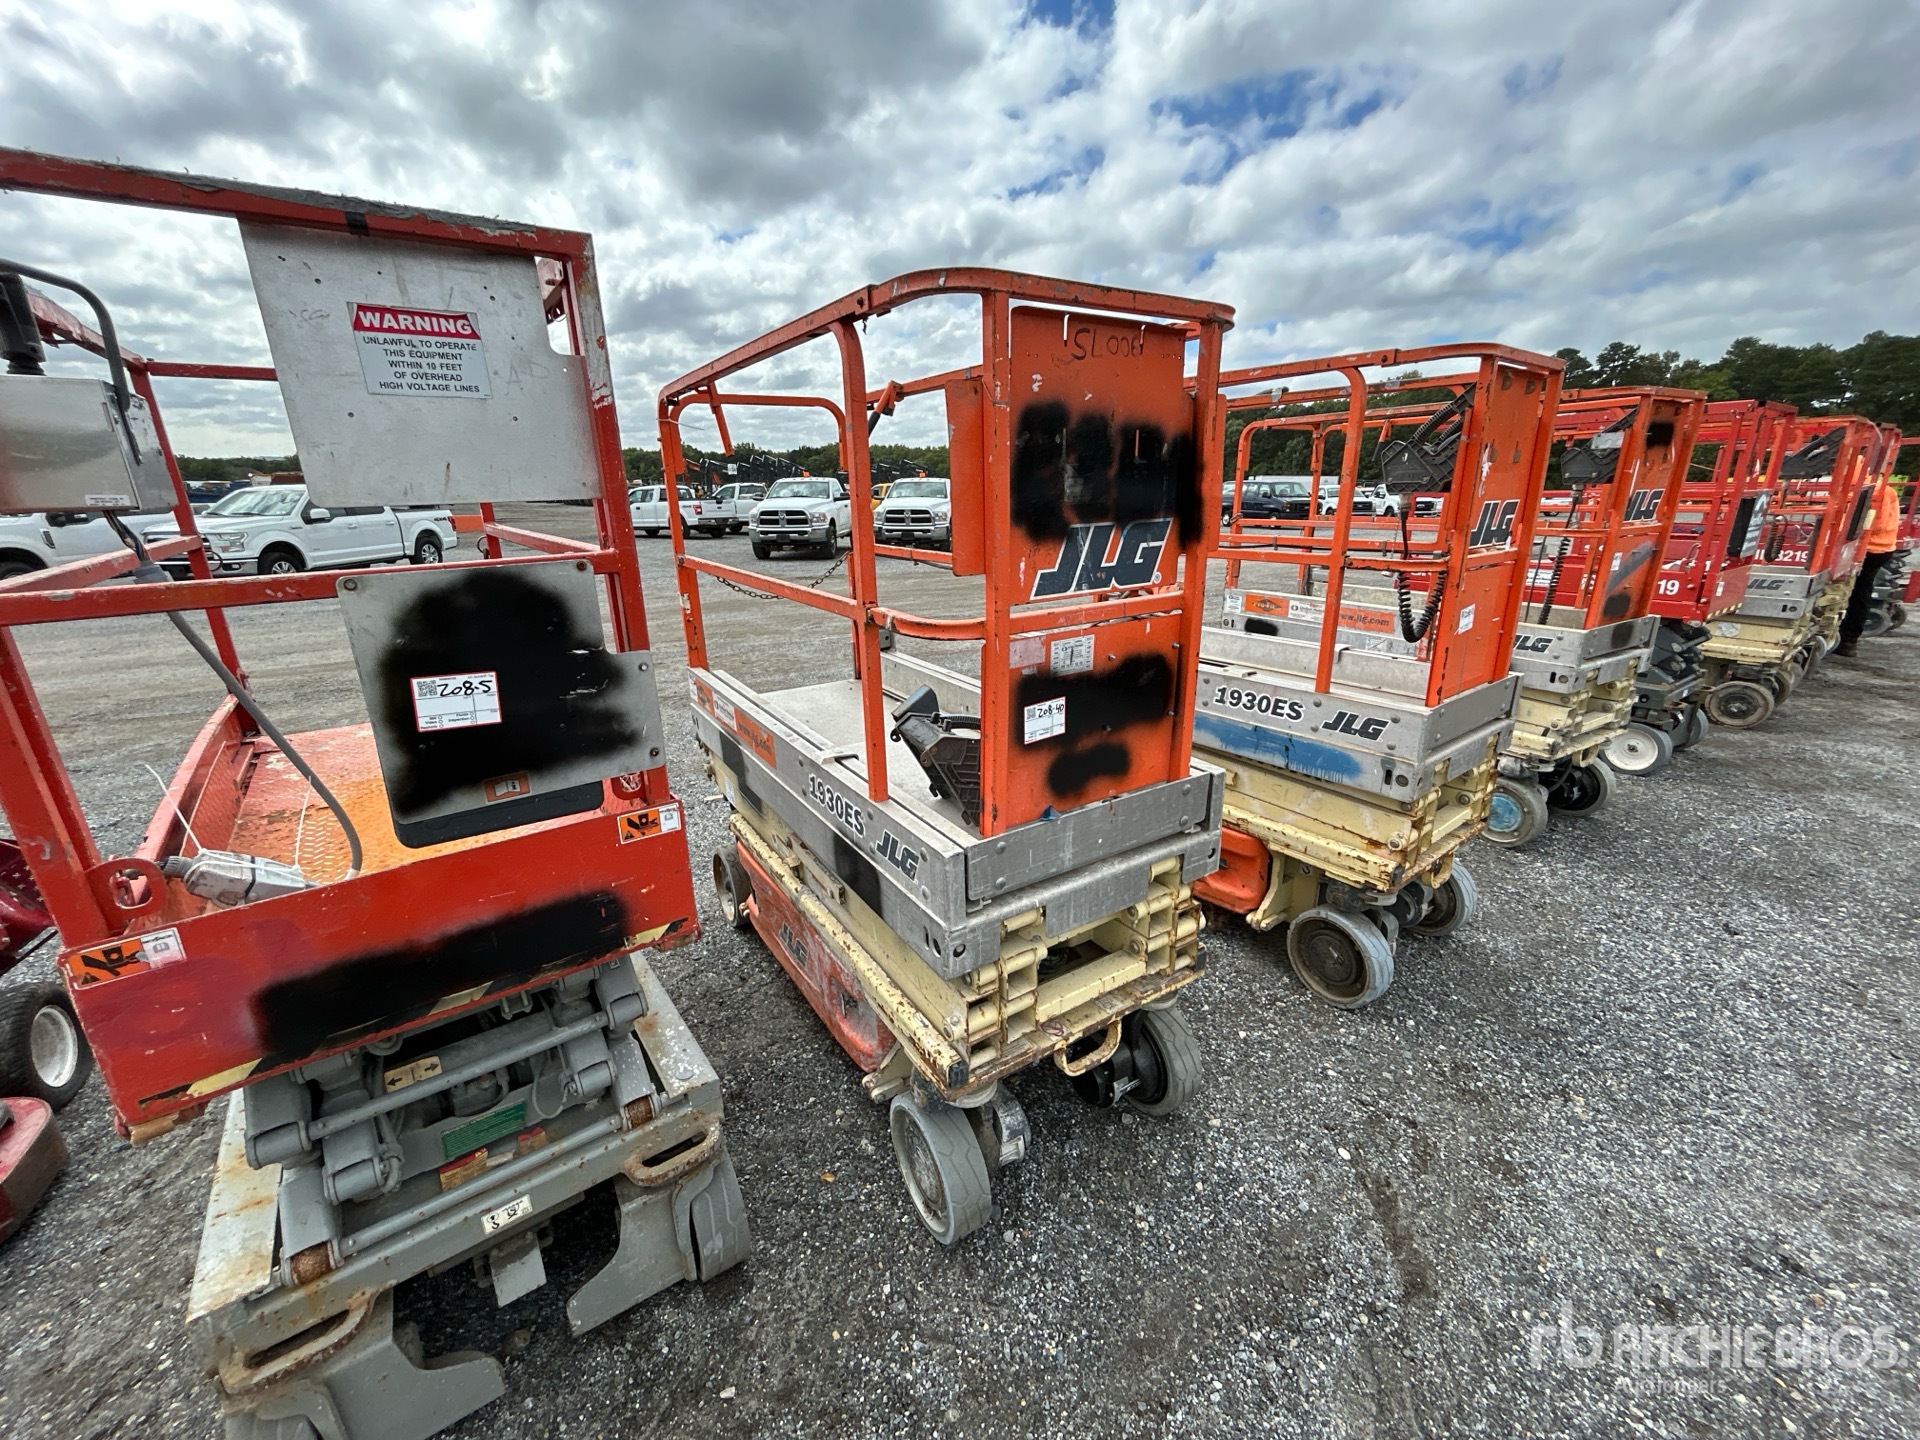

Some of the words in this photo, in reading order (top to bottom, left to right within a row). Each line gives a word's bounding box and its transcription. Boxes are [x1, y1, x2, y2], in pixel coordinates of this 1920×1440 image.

[357, 310, 473, 335] WARNING
[363, 335, 417, 349] UNLAWFUL
[419, 340, 432, 349] TO
[435, 341, 477, 352] OPERATE
[383, 348, 406, 358] THIS
[409, 350, 463, 361] EQUIPMENT
[388, 360, 422, 370] WITHIN
[426, 362, 437, 371] 10
[440, 363, 462, 371] FEET
[394, 371, 408, 380] OF
[411, 372, 462, 382] OVERHEAD
[379, 381, 403, 390] HIGH
[406, 383, 451, 392] VOLTAGE
[454, 385, 479, 393] LINES
[1468, 499, 1521, 549] JLG
[1030, 518, 1174, 600] JLG
[1747, 578, 1785, 590] JLG
[1340, 613, 1390, 626] ww.jlg.com
[1213, 685, 1306, 723] 1930ES
[1321, 710, 1390, 742] JLG
[808, 773, 867, 839] 1930ES
[875, 829, 920, 882] JLG
[779, 921, 809, 969] JLG
